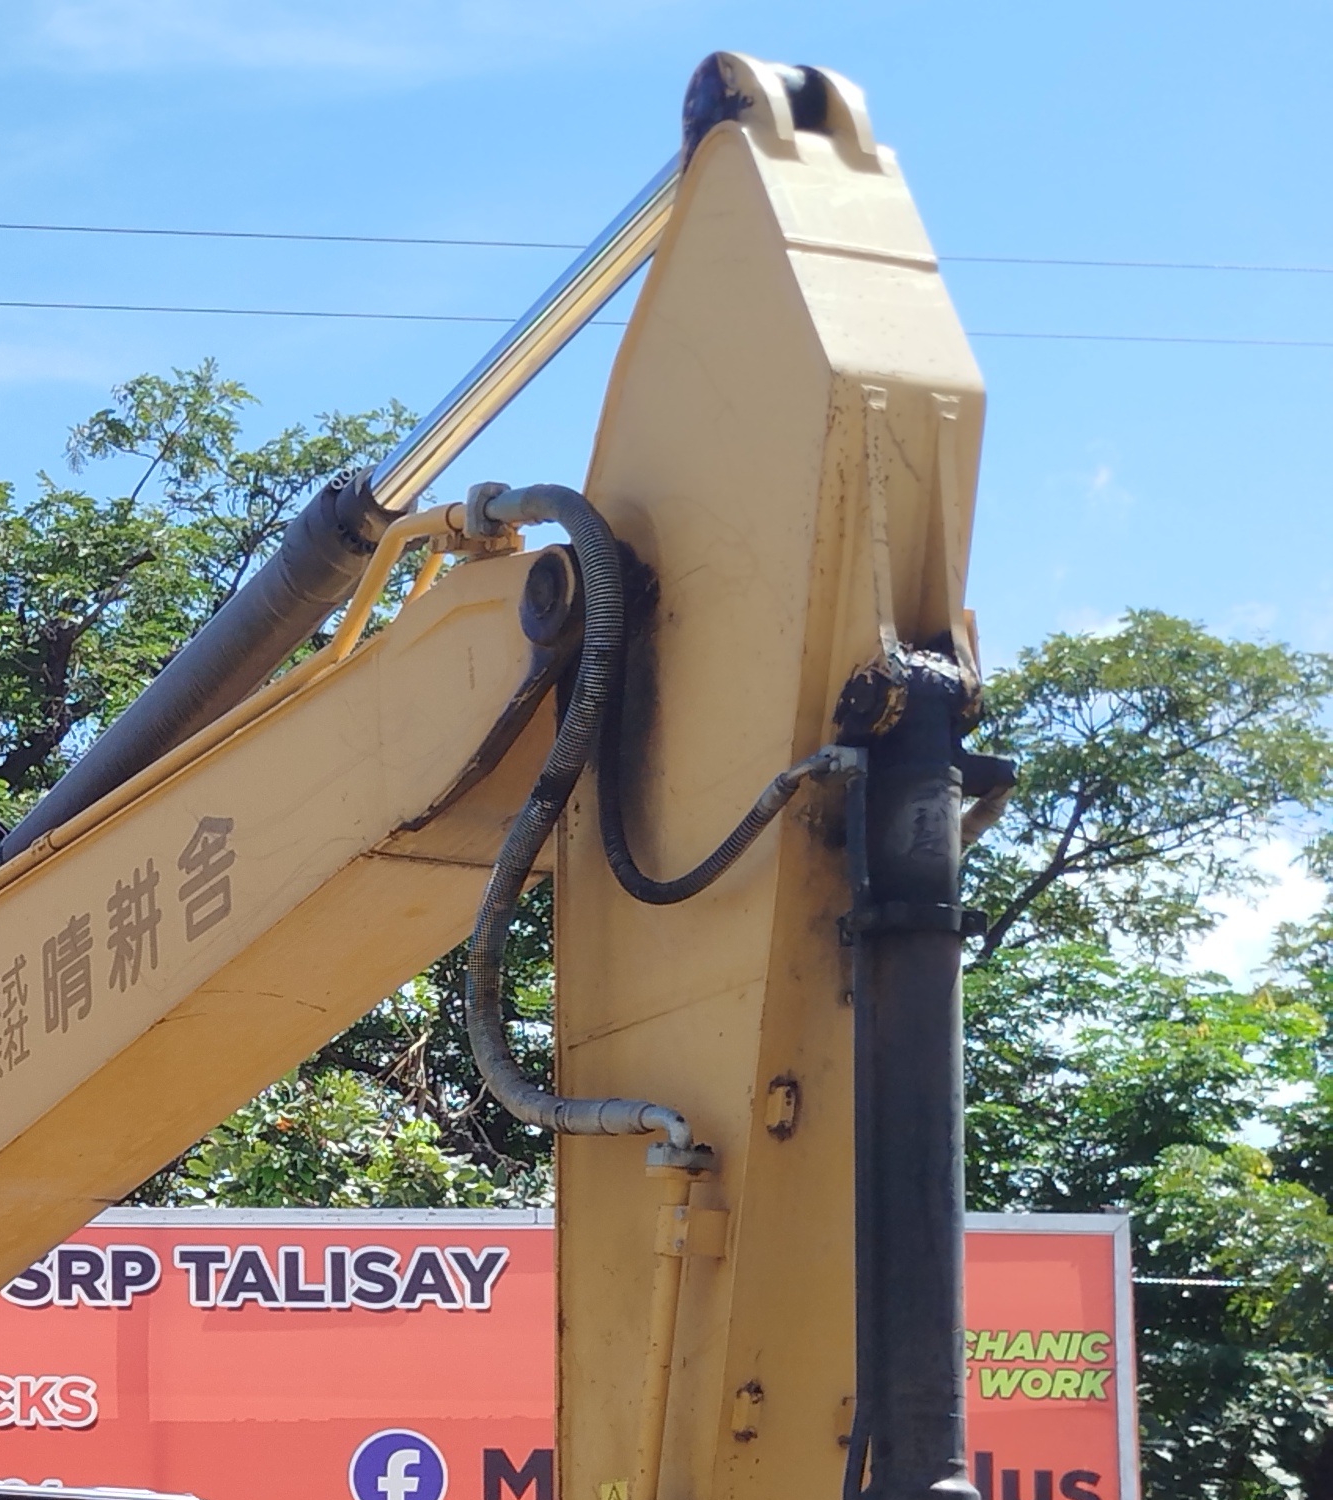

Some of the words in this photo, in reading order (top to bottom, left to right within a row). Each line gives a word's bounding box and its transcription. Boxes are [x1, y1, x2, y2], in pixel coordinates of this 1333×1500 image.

[42, 815, 236, 1034] 晴耕舎
[174, 1244, 509, 1310] TALISAY
[979, 1367, 1113, 1400] WORK
